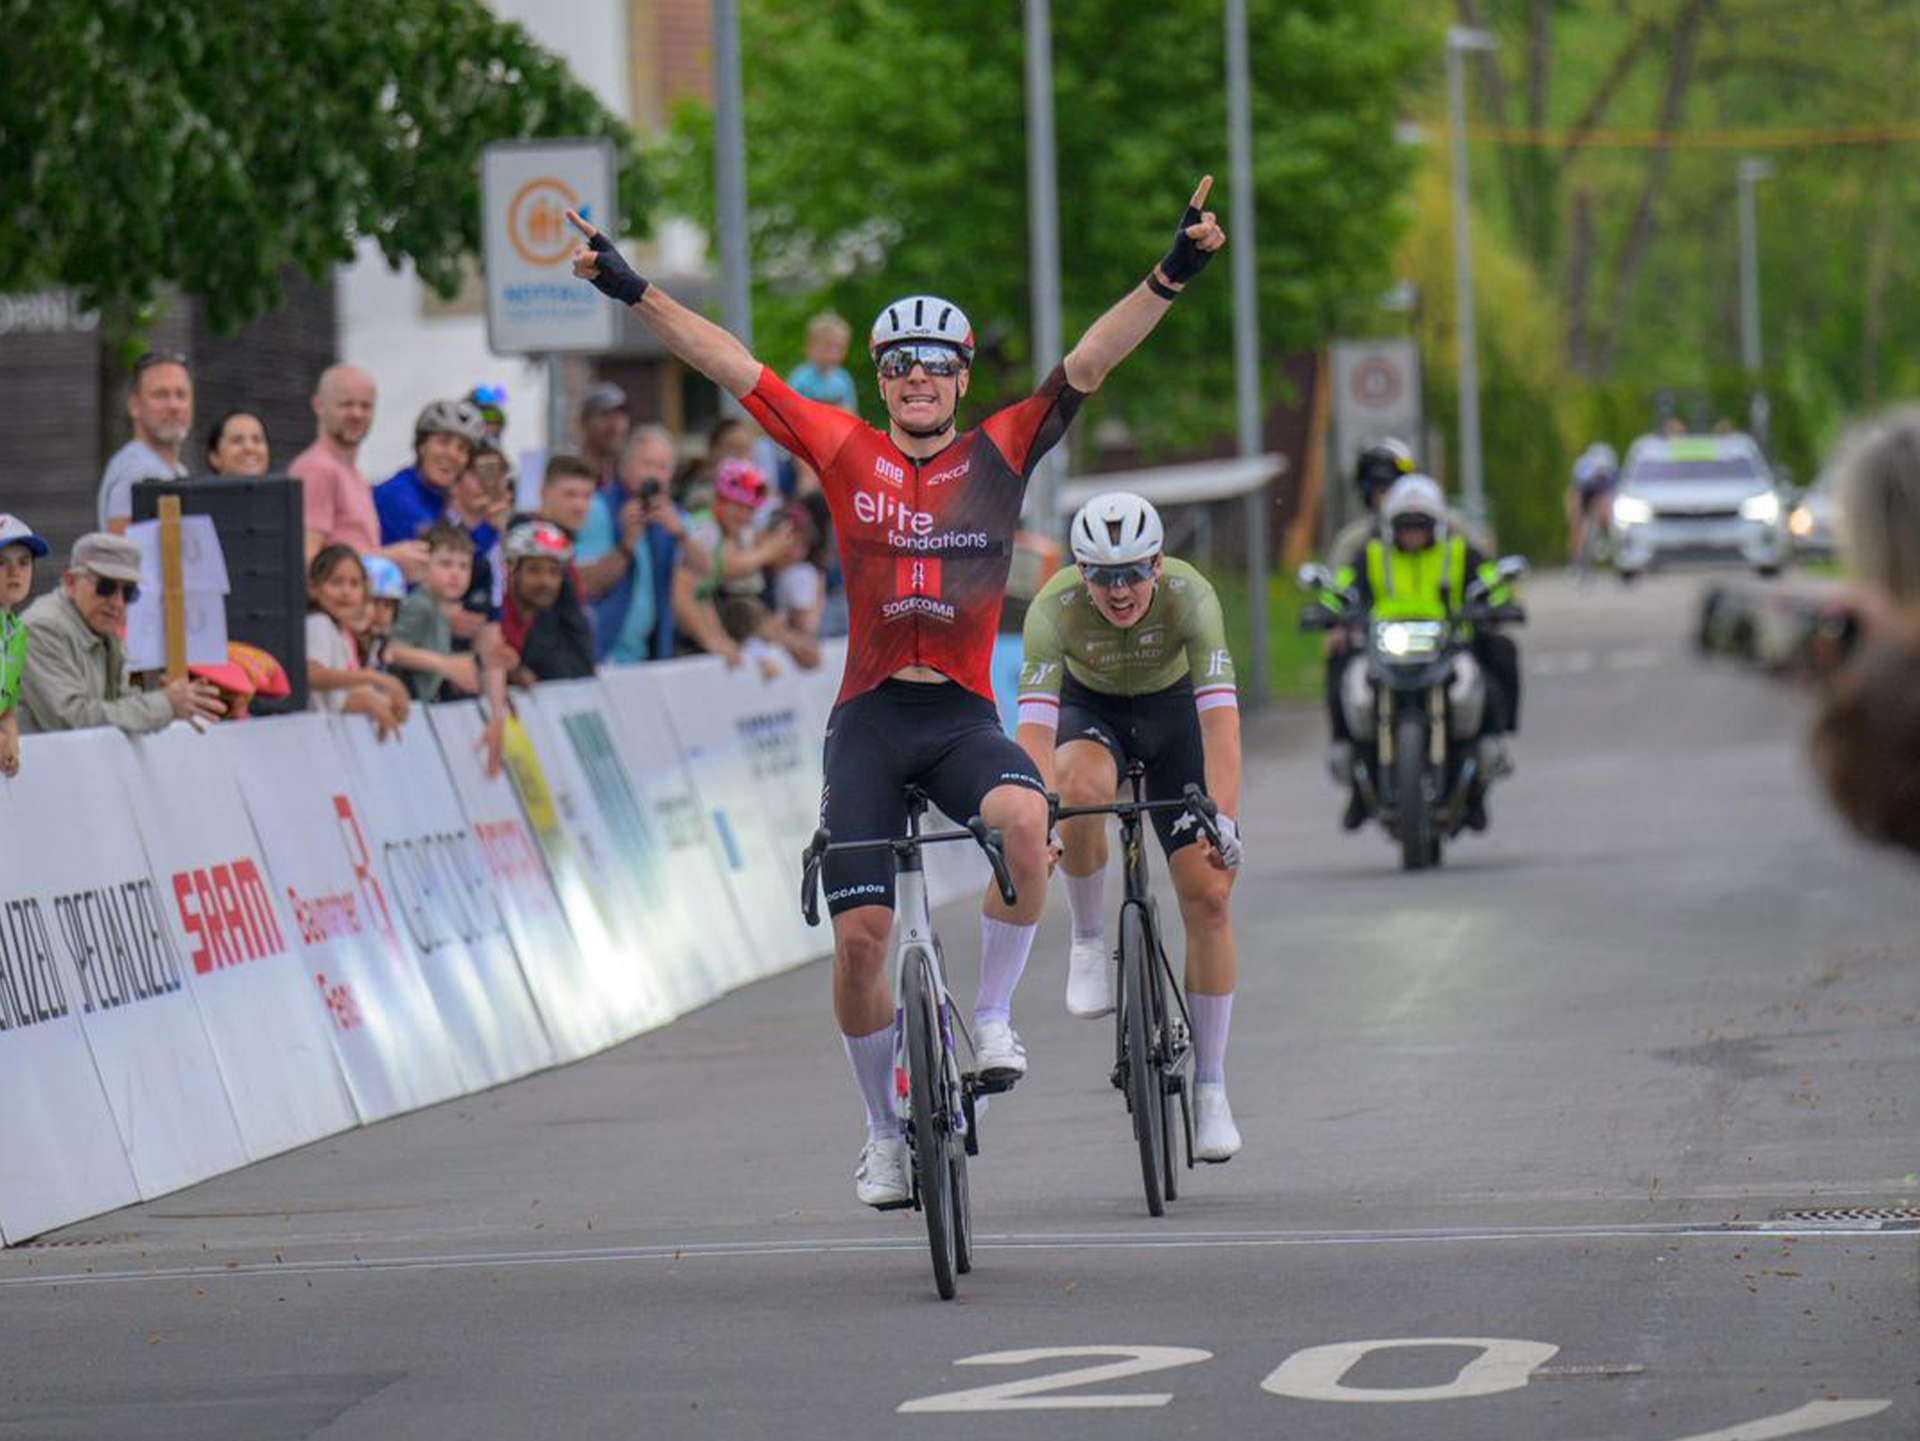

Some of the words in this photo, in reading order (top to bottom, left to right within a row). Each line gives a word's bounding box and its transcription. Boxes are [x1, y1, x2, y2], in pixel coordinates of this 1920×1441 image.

[854, 490, 933, 536] elite
[888, 530, 987, 549] fondations
[882, 597, 955, 619] SOGECOMA
[172, 856, 284, 975] SRAM
[897, 1337, 1560, 1412] 20
